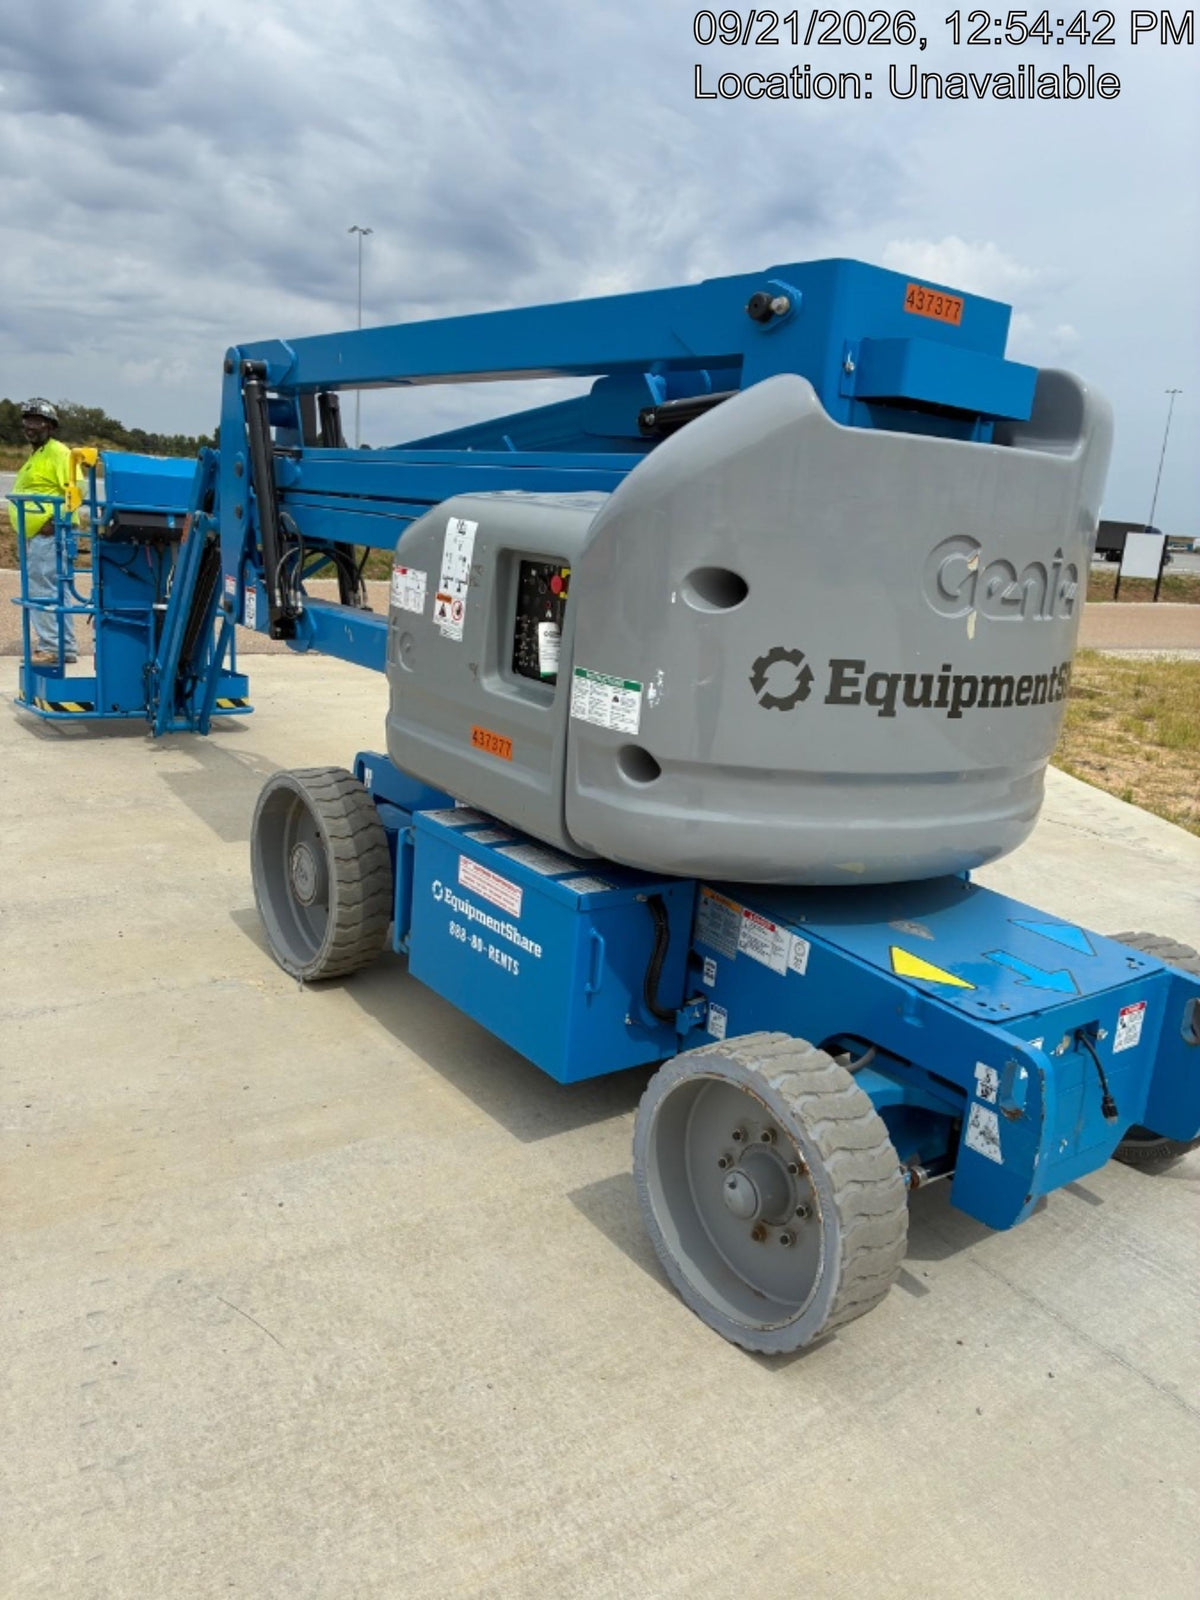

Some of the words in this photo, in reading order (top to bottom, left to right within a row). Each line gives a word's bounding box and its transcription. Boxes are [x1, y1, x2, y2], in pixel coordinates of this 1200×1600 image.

[905, 288, 962, 320] 437377
[921, 534, 1079, 622] Genie
[824, 659, 1072, 718] EquipmentS
[471, 729, 513, 757] 437377
[444, 887, 543, 958] EquipmentShare
[448, 919, 520, 976] 888-80-RENTS
